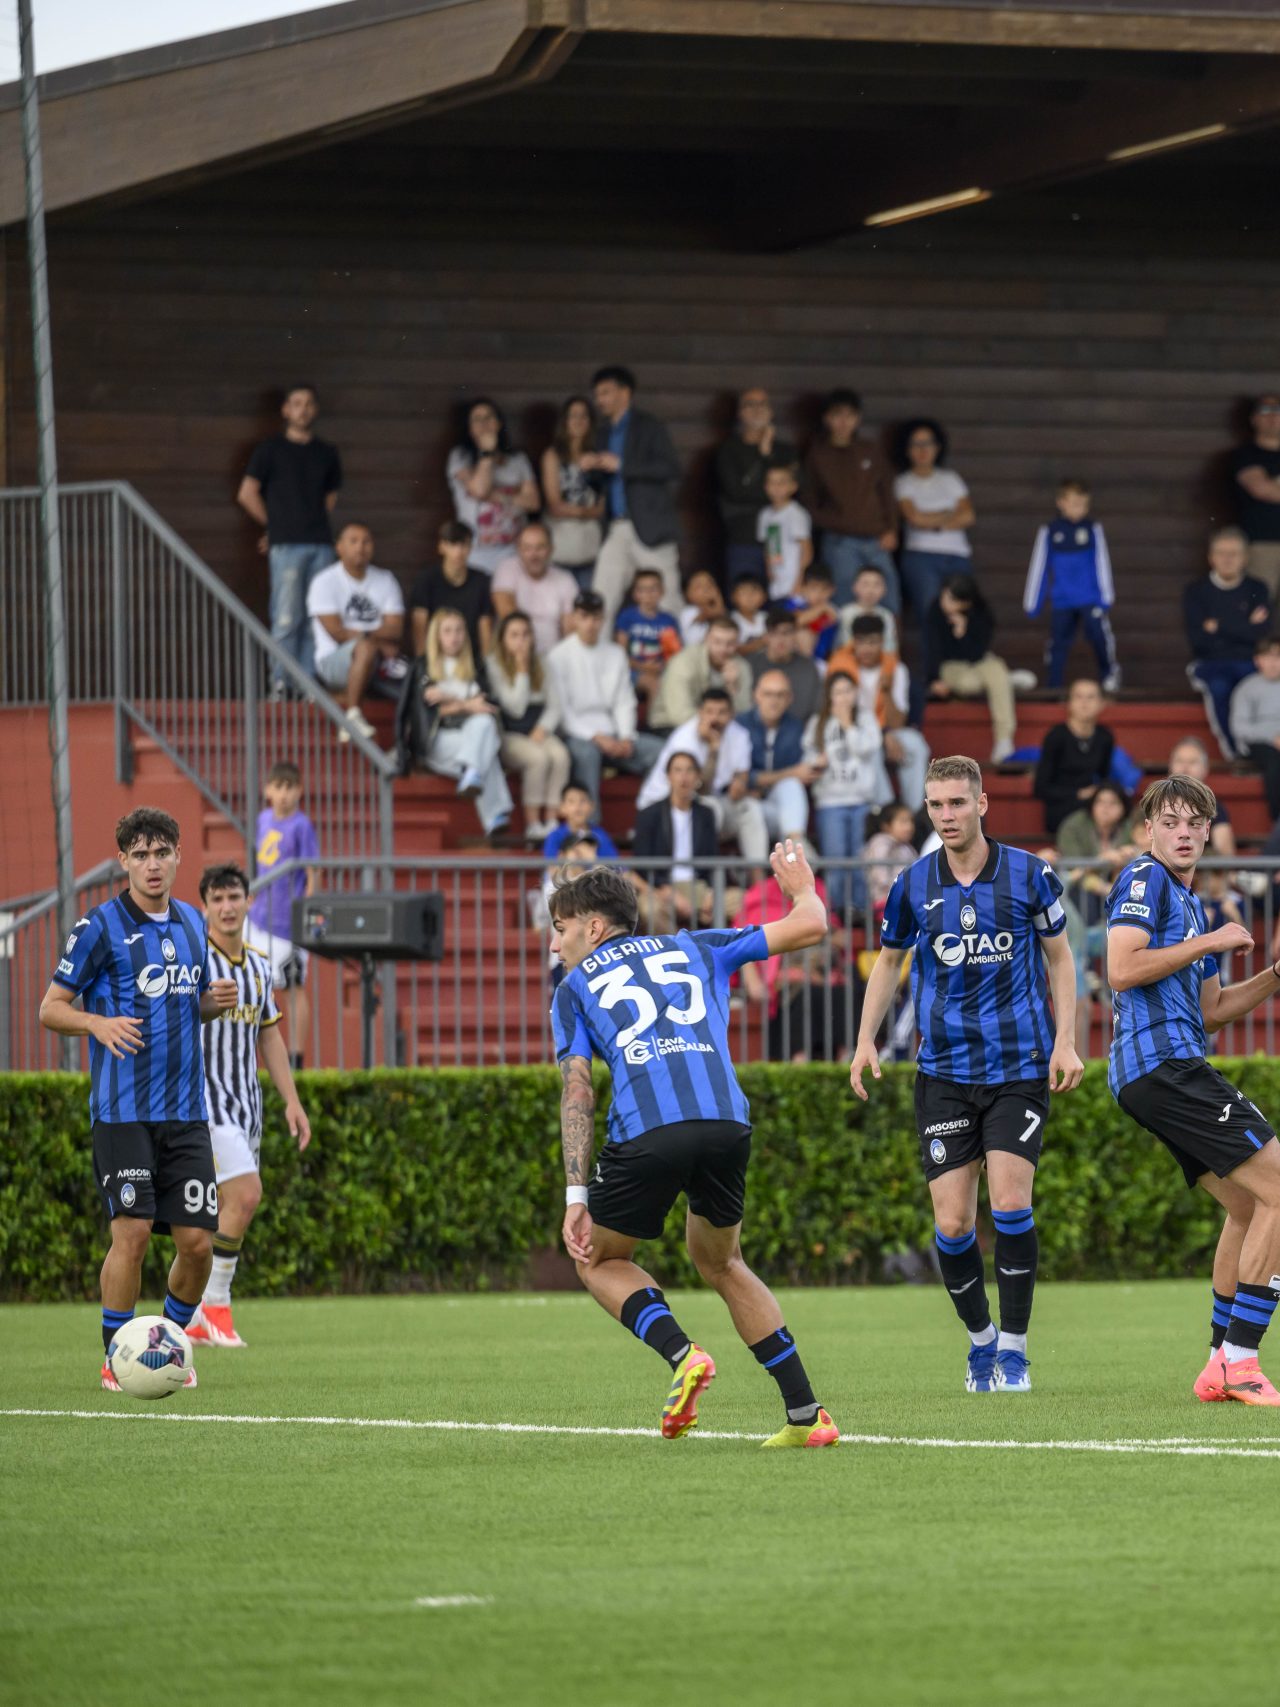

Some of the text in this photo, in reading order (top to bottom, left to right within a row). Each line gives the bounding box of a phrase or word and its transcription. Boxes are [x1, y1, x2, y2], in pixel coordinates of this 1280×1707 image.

[1123, 905, 1148, 915] NOW
[962, 932, 1014, 954] TAO
[582, 938, 665, 974] GUERINI
[967, 951, 1014, 966] AMBIENTE
[166, 964, 202, 985] TAO
[587, 951, 707, 1048] 35
[656, 1035, 687, 1048] CAVA
[658, 1042, 715, 1056] GHISALBA
[924, 1118, 970, 1136] ARGOSPED
[1018, 1108, 1041, 1142] 7
[184, 1178, 218, 1217] 99
